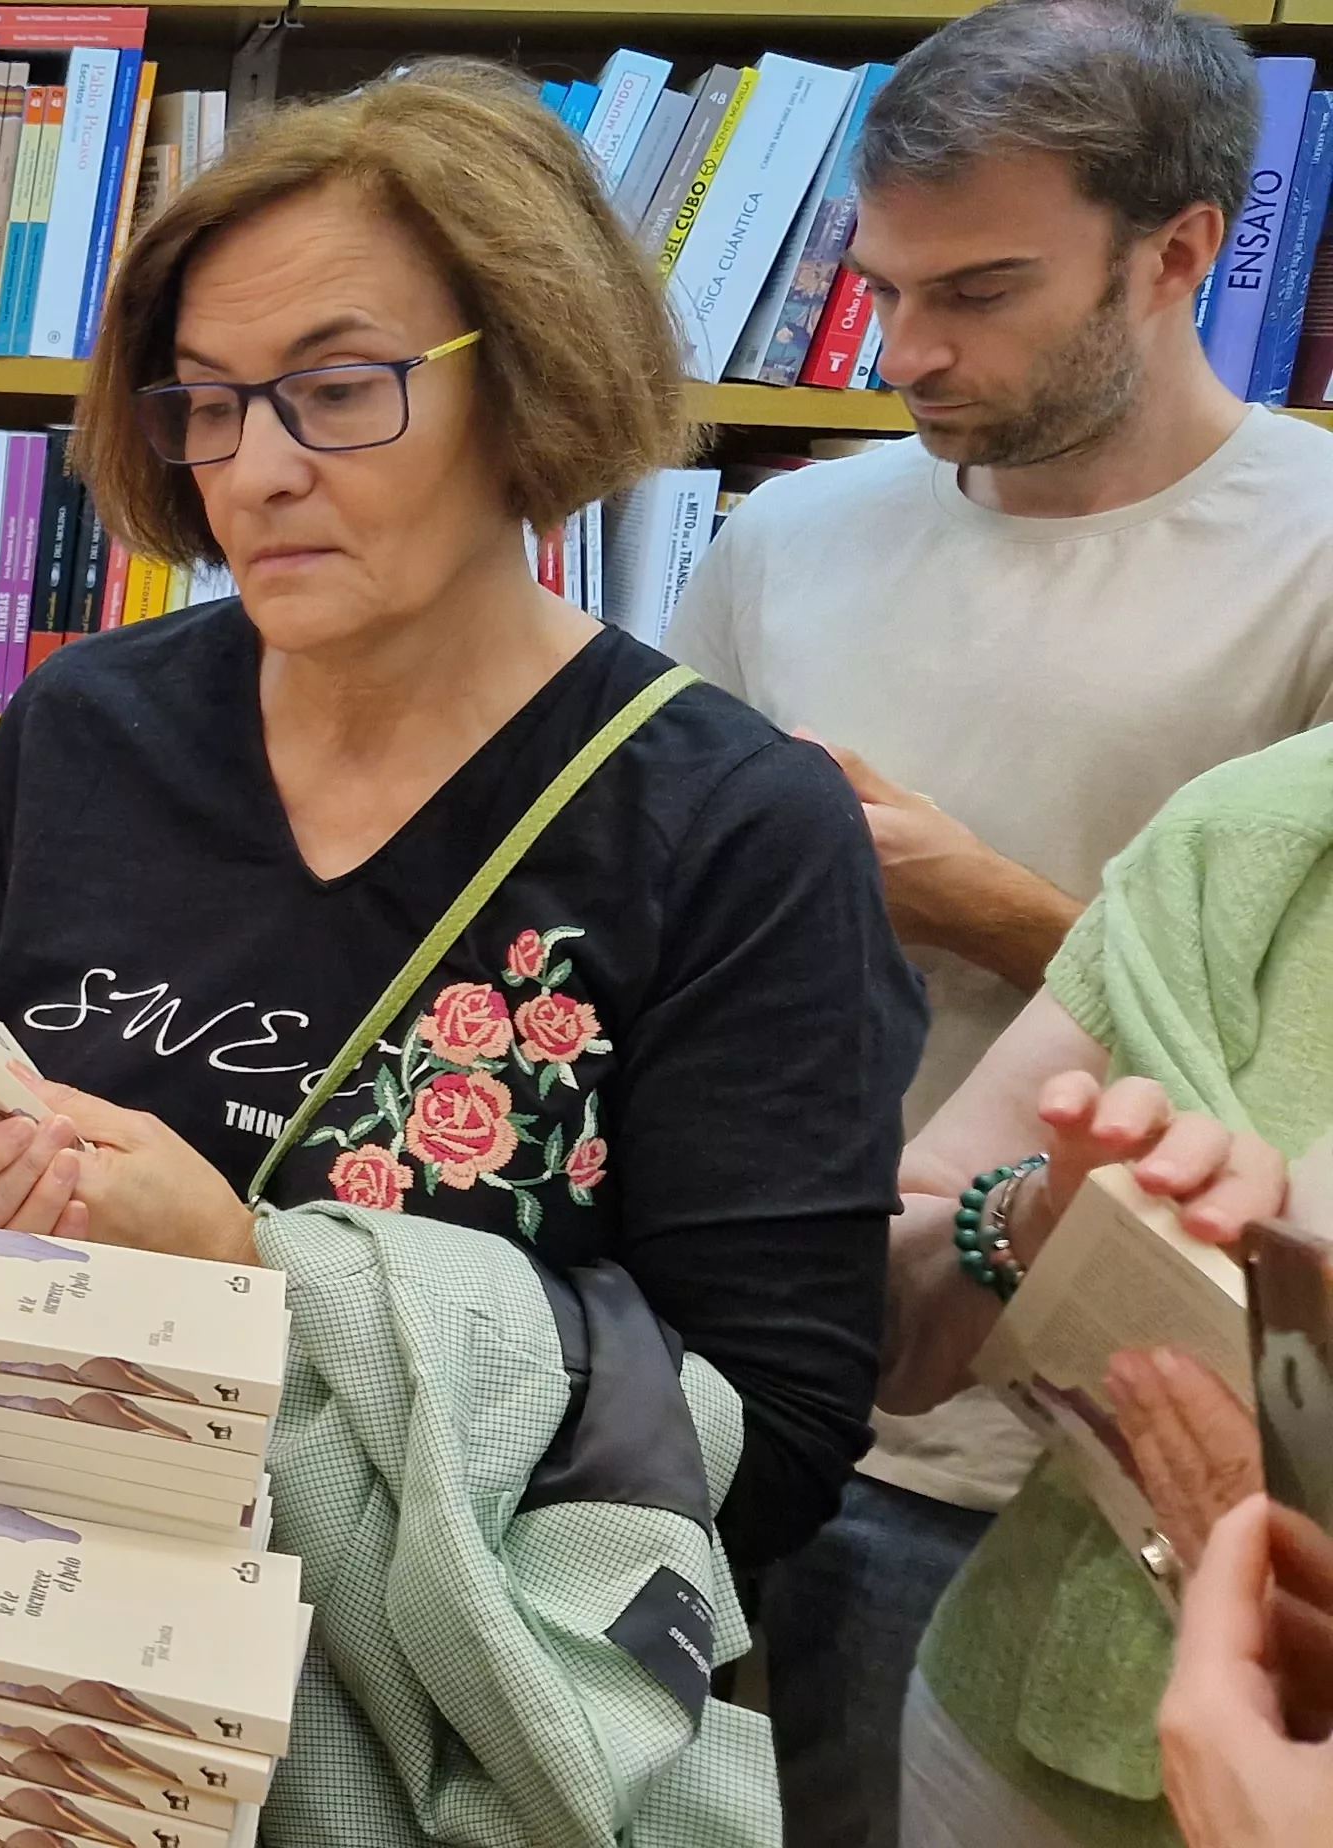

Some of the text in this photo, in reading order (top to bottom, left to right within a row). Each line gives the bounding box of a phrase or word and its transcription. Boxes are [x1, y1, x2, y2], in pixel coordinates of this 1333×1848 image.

[608, 79, 634, 130] MUNDO
[709, 91, 727, 105] 48
[676, 181, 706, 231] CUBO
[712, 116, 734, 153] VICENTE
[1228, 168, 1283, 291] ENSAYO
[697, 191, 763, 322] FÍSICA CUÁNTICA
[841, 297, 860, 330] Ocho
[685, 502, 699, 529] MITO
[53, 542, 62, 558] DEL
[90, 544, 98, 559] DEL
[14, 593, 29, 643] INTENSAS
[24, 1569, 52, 1617] oscurece
[53, 1556, 82, 1593] el pelo
